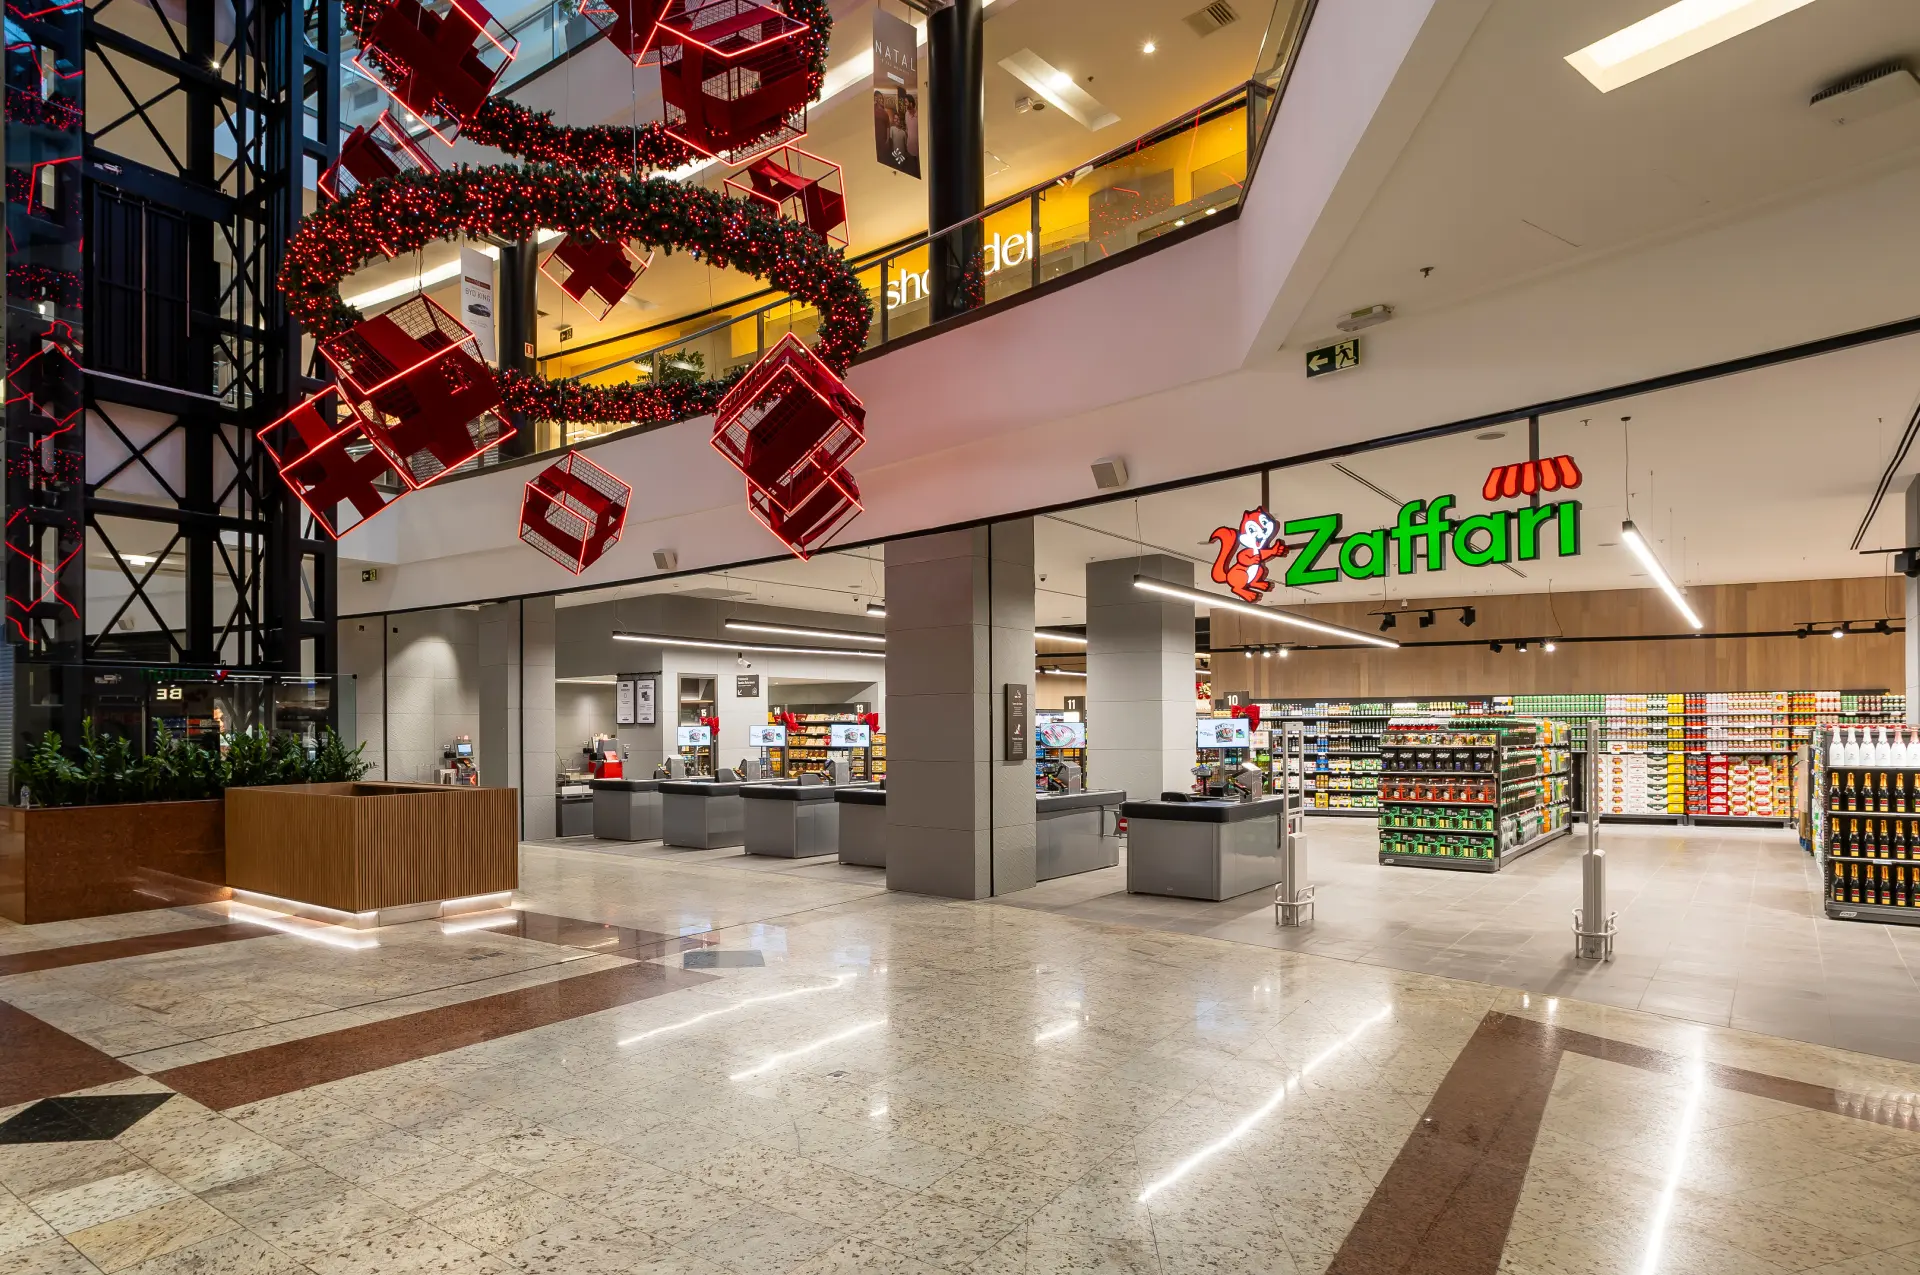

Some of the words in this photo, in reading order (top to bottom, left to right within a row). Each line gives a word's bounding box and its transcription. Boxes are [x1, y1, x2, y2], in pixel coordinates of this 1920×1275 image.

[875, 39, 916, 72] NATAL
[1284, 494, 1582, 587] Zaffari
[1067, 699, 1076, 710] 11
[1227, 694, 1239, 706] 10
[700, 708, 707, 717] 15
[773, 706, 781, 715] 14
[856, 704, 864, 713] 13
